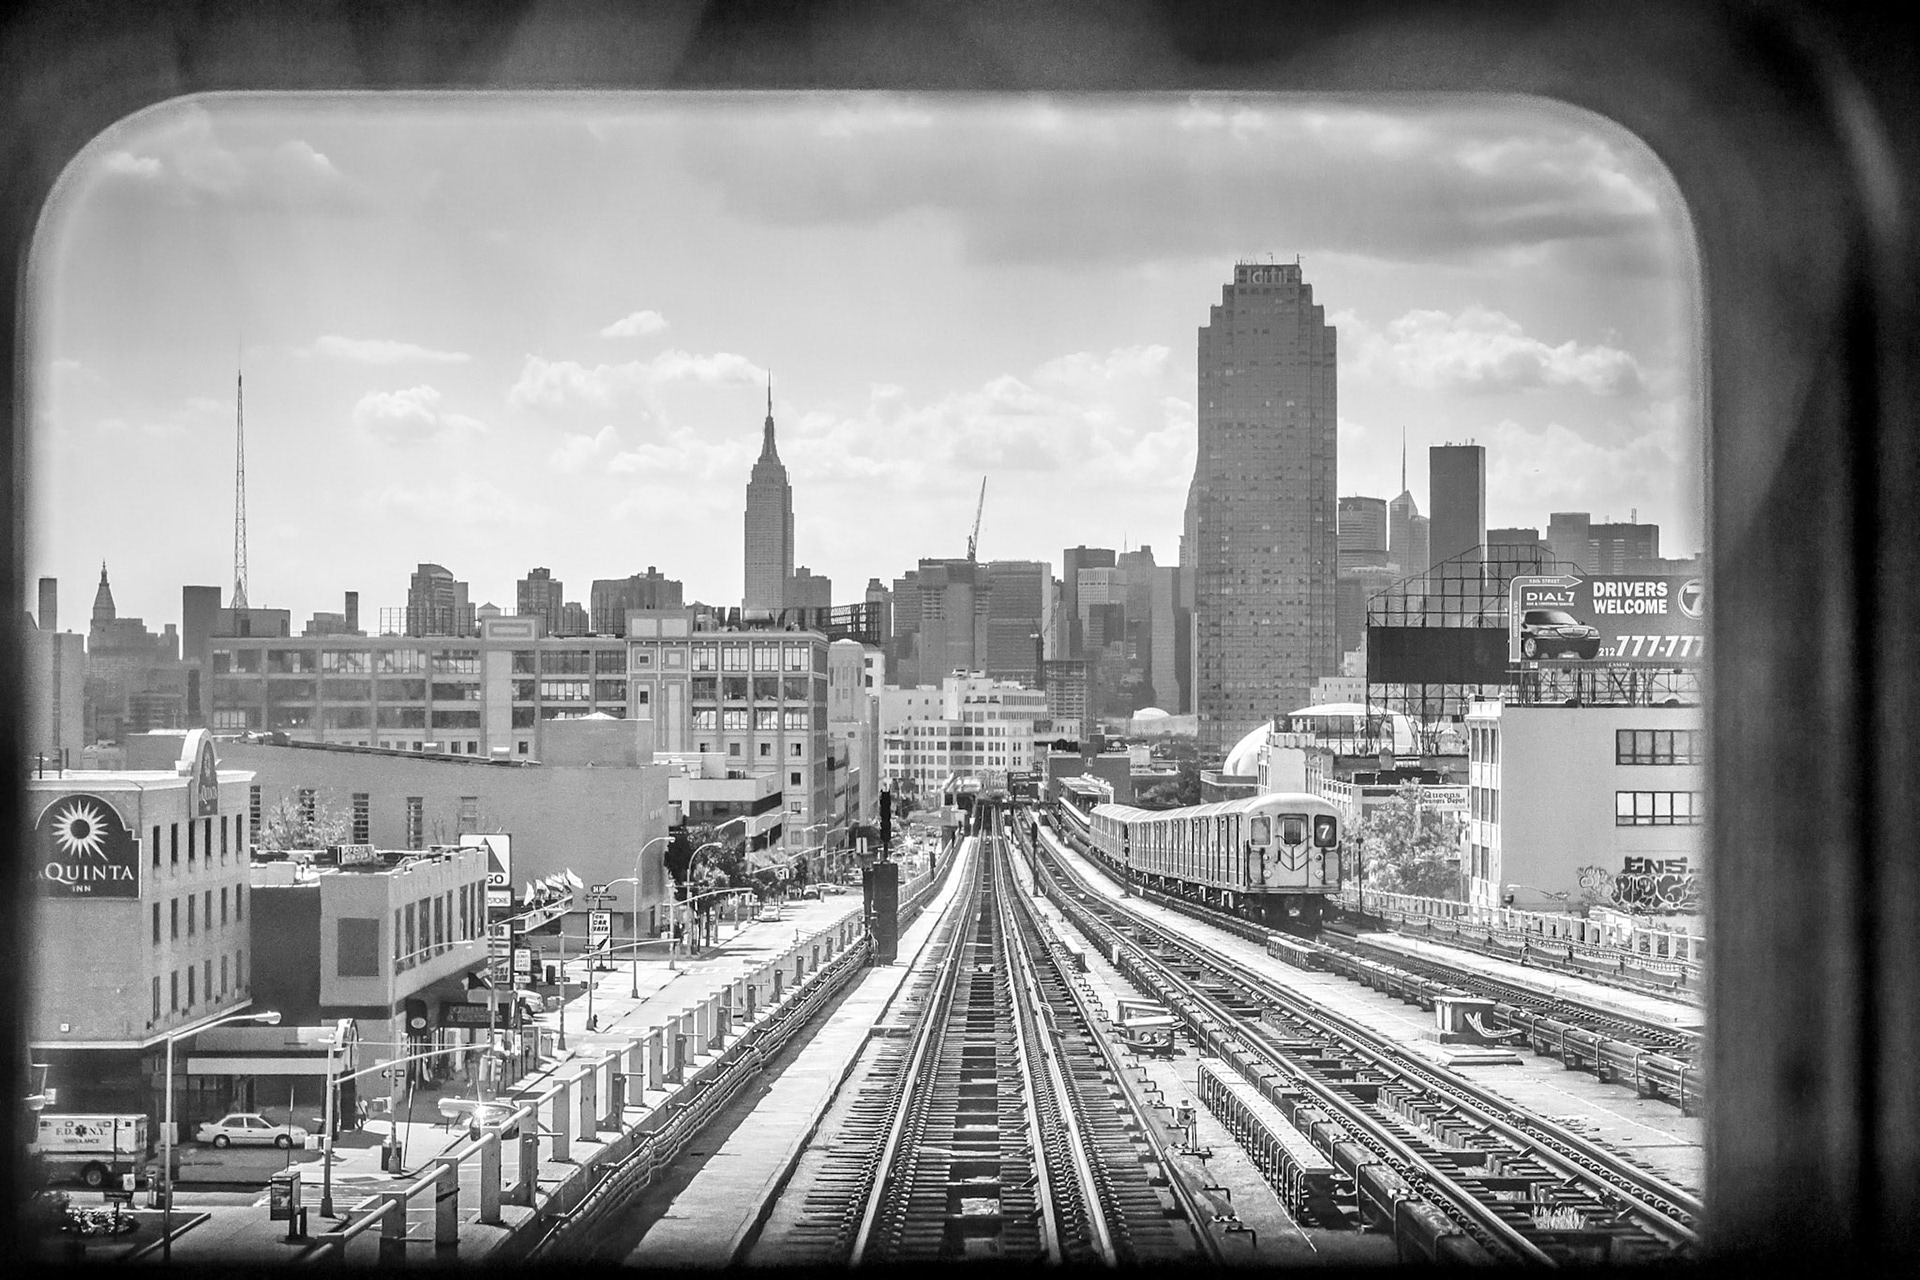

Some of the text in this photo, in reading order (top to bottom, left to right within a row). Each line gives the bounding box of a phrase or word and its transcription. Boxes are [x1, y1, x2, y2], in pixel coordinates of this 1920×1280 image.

[1593, 582, 1668, 597] DRIVERS
[1593, 599, 1668, 614] WELCOME
[1599, 647, 1615, 656] 212
[1424, 791, 1461, 799] Queens
[1320, 825, 1330, 839] 7
[45, 862, 134, 885] QUINTA
